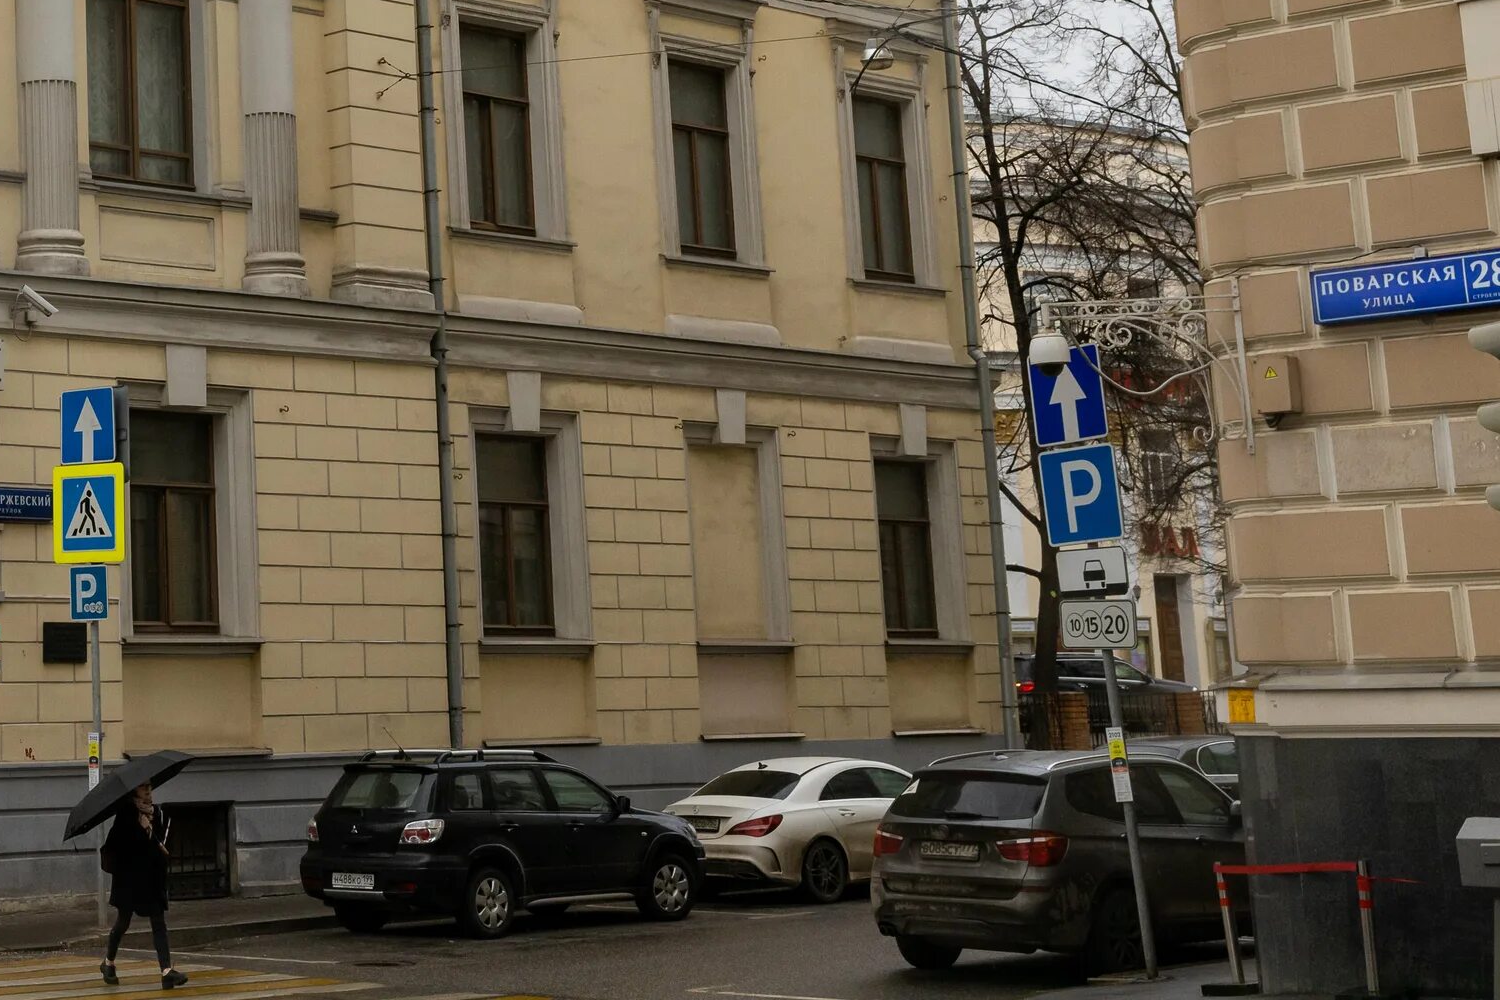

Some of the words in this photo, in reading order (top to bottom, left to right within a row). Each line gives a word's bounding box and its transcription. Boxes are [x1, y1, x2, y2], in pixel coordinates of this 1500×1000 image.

[1321, 265, 1456, 296] ПОВАРСКАЯ
[1362, 293, 1415, 309] УЛИЦА
[0, 494, 51, 506] РЖЕВСКИЙ
[1061, 459, 1102, 533] P
[76, 573, 97, 613] P
[1070, 618, 1081, 632] 10
[1085, 617, 1099, 633] 15
[1104, 615, 1126, 634] 20
